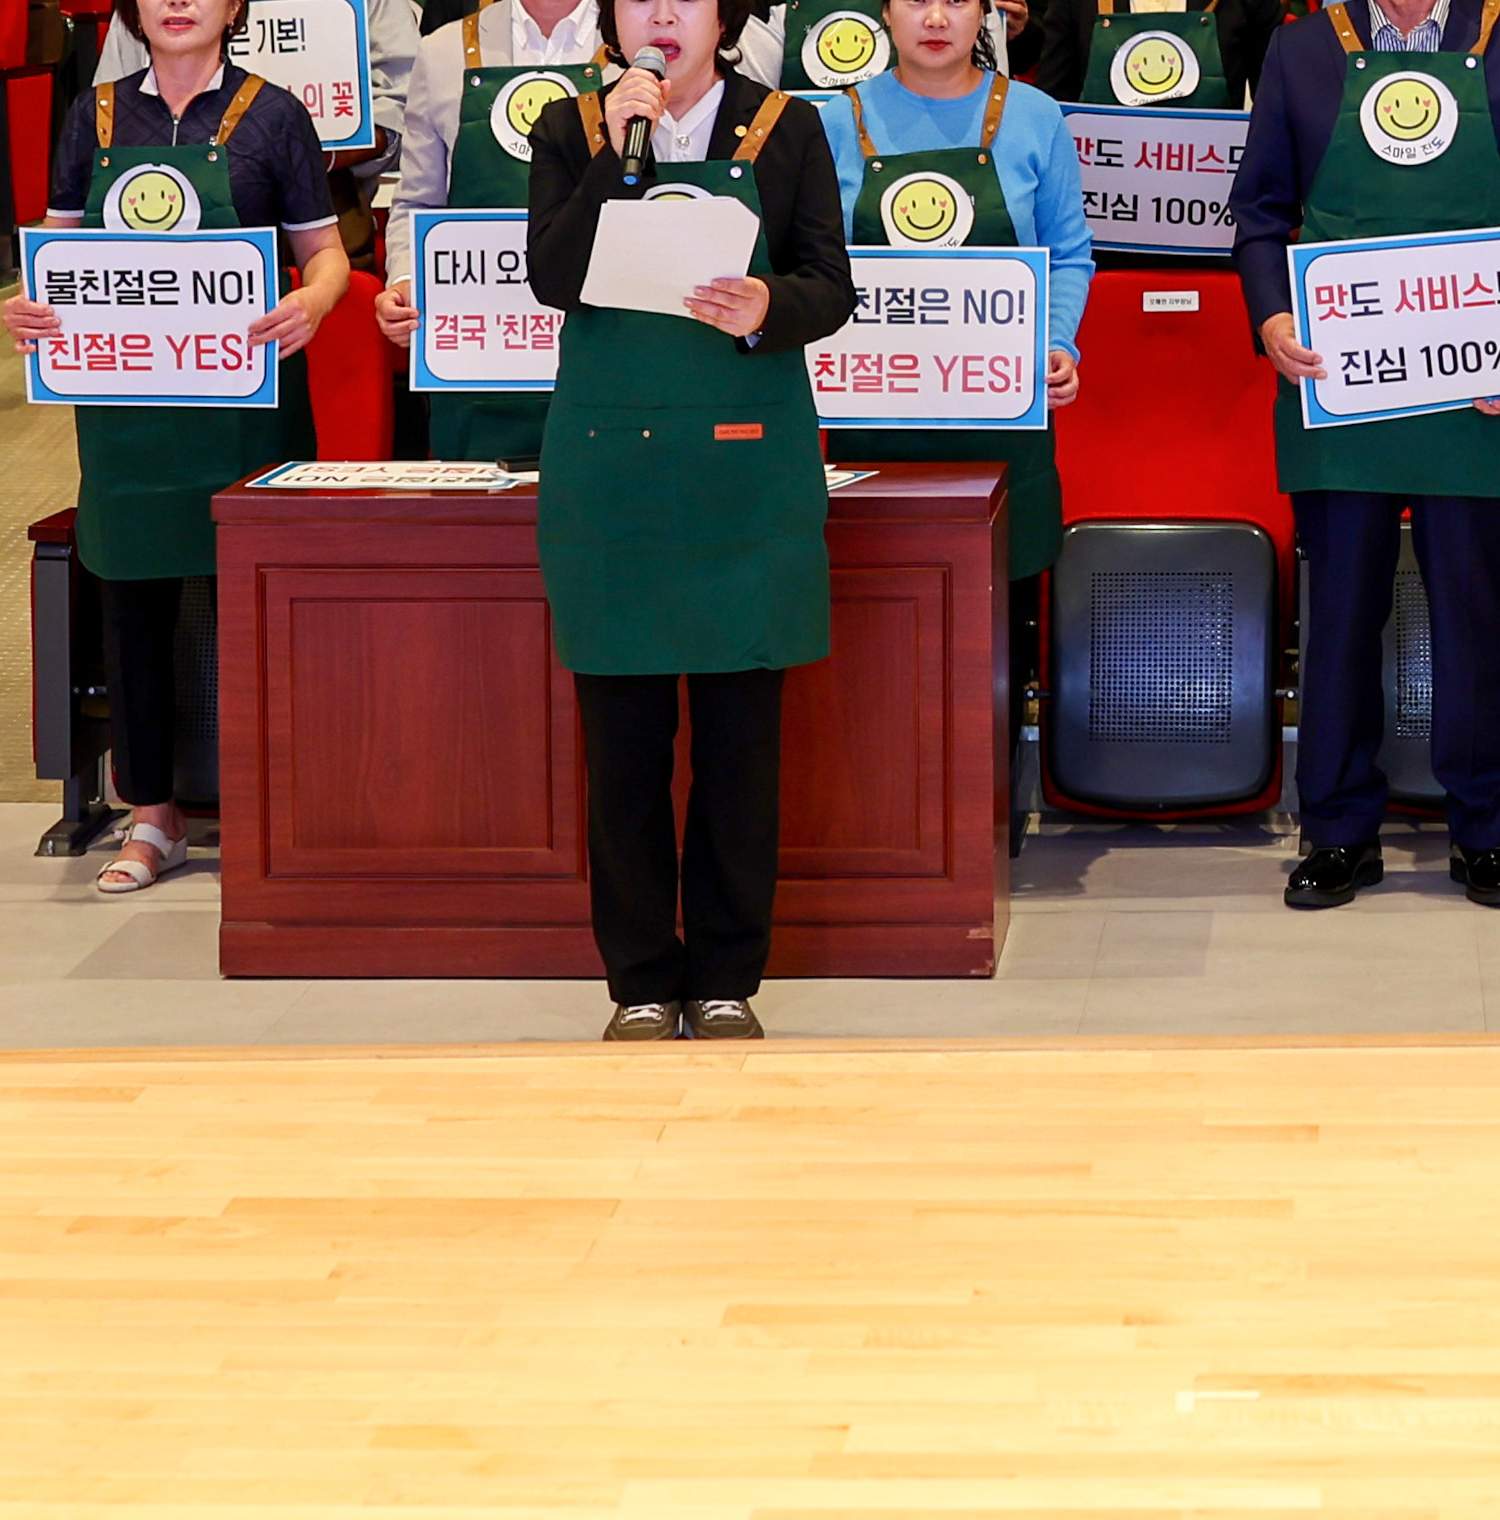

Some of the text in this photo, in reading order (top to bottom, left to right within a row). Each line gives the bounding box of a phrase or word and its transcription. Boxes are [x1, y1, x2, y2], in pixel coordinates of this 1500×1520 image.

[257, 18, 305, 53] 기본!
[332, 82, 353, 117] 꽃
[1382, 137, 1444, 158] 스마일 진도
[1082, 191, 1235, 225] 진심 100%
[435, 250, 485, 285] 다시
[45, 270, 254, 305] 불친절은 NO!
[1315, 282, 1383, 321] 맛도
[964, 290, 1024, 324] NO!
[435, 315, 486, 350] 결국
[49, 334, 252, 371] 친절은 YES!
[1341, 347, 1407, 386] 진심
[814, 353, 1021, 393] 친절은 YES!
